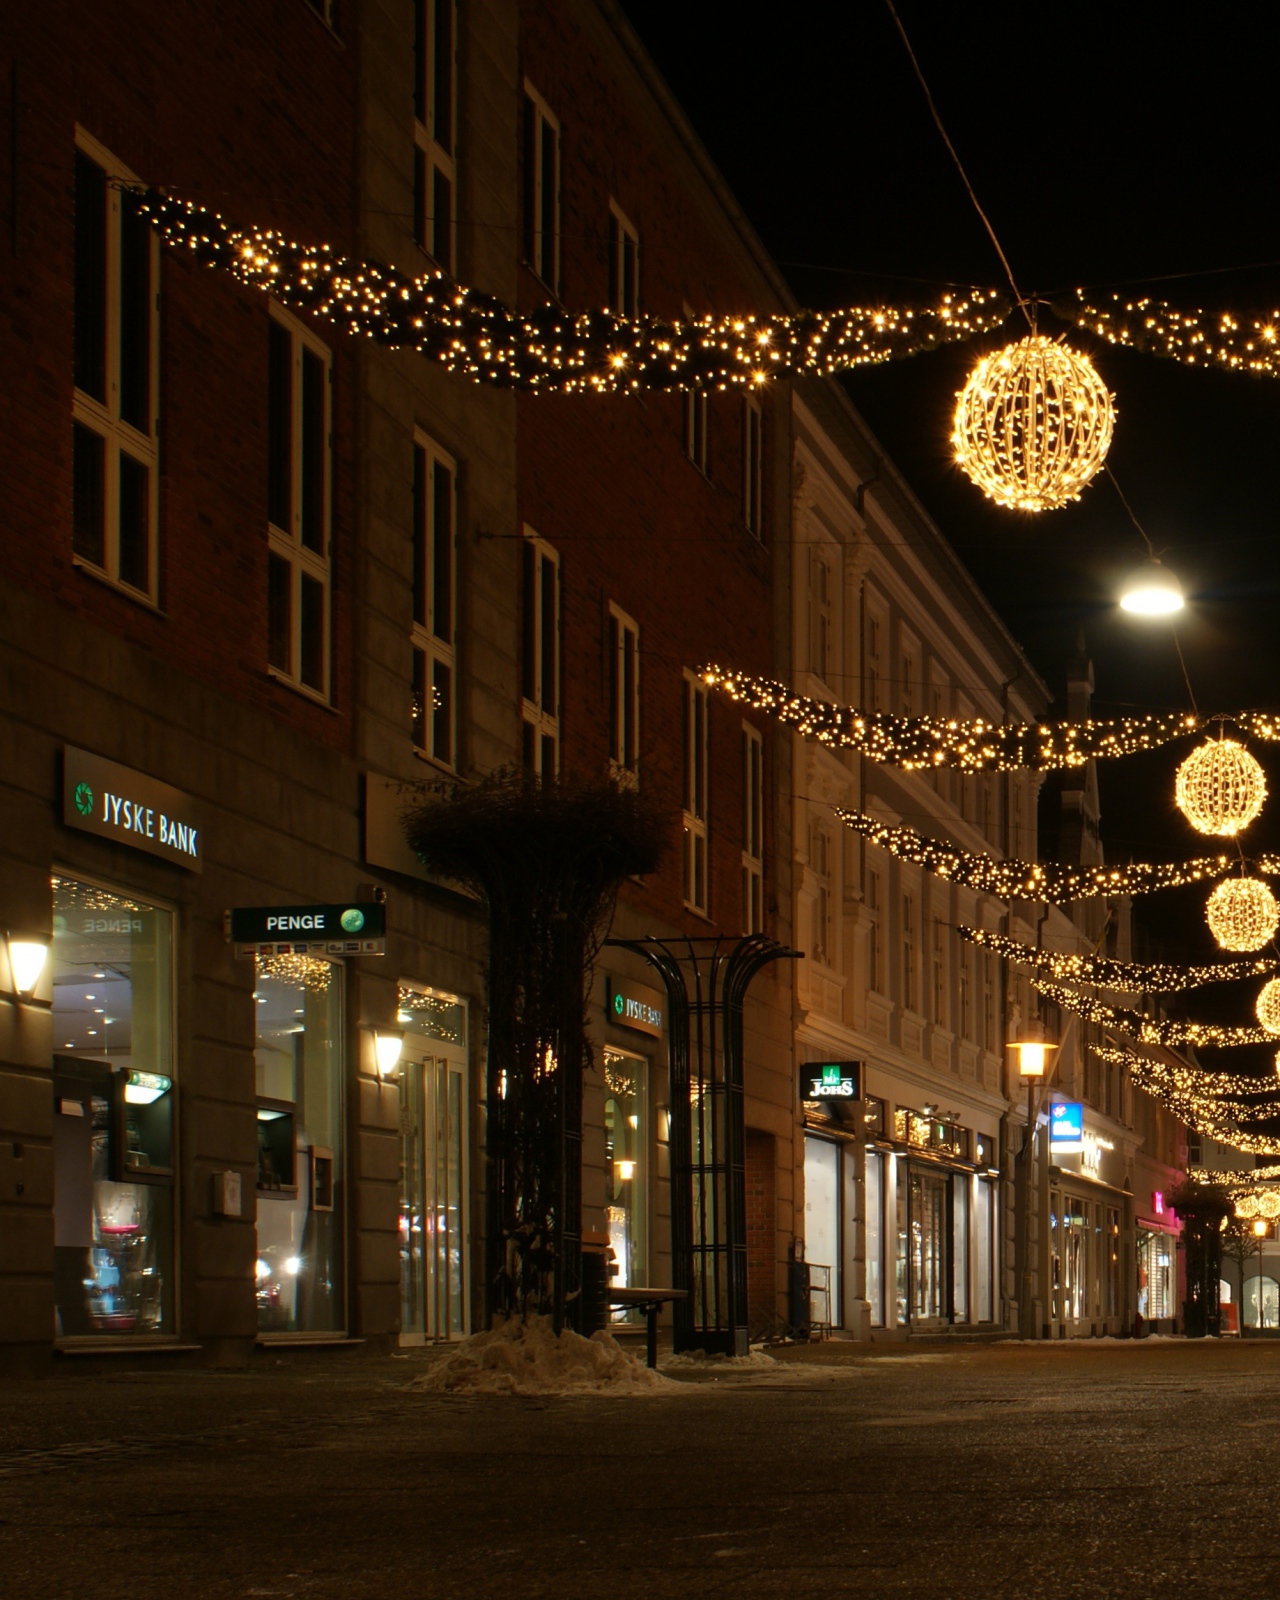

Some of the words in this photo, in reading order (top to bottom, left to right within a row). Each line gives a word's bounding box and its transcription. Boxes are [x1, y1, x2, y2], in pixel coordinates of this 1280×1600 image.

[103, 792, 154, 838] JYSKE
[159, 813, 198, 857] BANK
[267, 914, 325, 931] PENGE
[626, 998, 647, 1022] JYSKE
